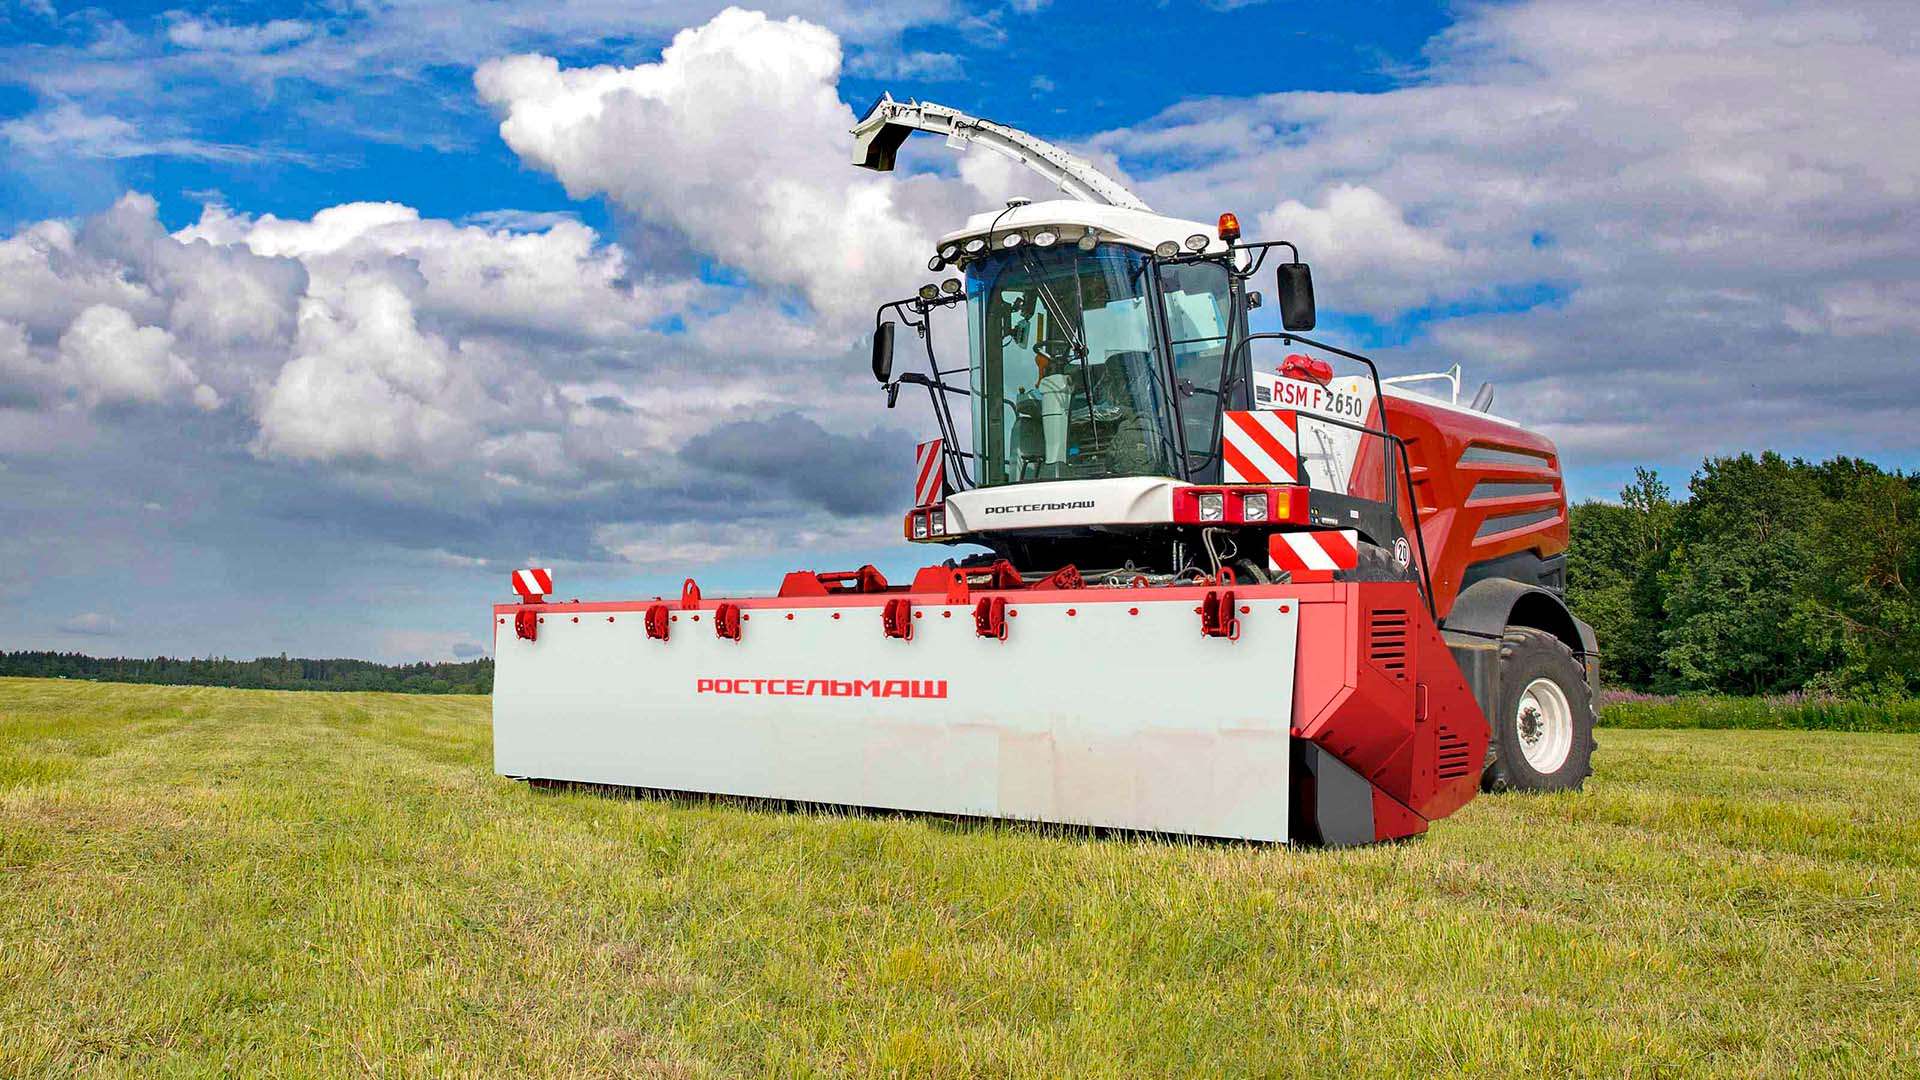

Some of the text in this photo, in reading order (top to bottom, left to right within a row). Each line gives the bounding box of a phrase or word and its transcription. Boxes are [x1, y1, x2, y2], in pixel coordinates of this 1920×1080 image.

[1273, 381, 1307, 408] RSM
[1313, 388, 1322, 409] F
[1325, 392, 1362, 418] 2650
[985, 500, 1095, 515] РОСТСЕЛЬМАШ
[1398, 543, 1407, 562] 20
[697, 679, 949, 699] РОСТСЕЛЬМАШ
